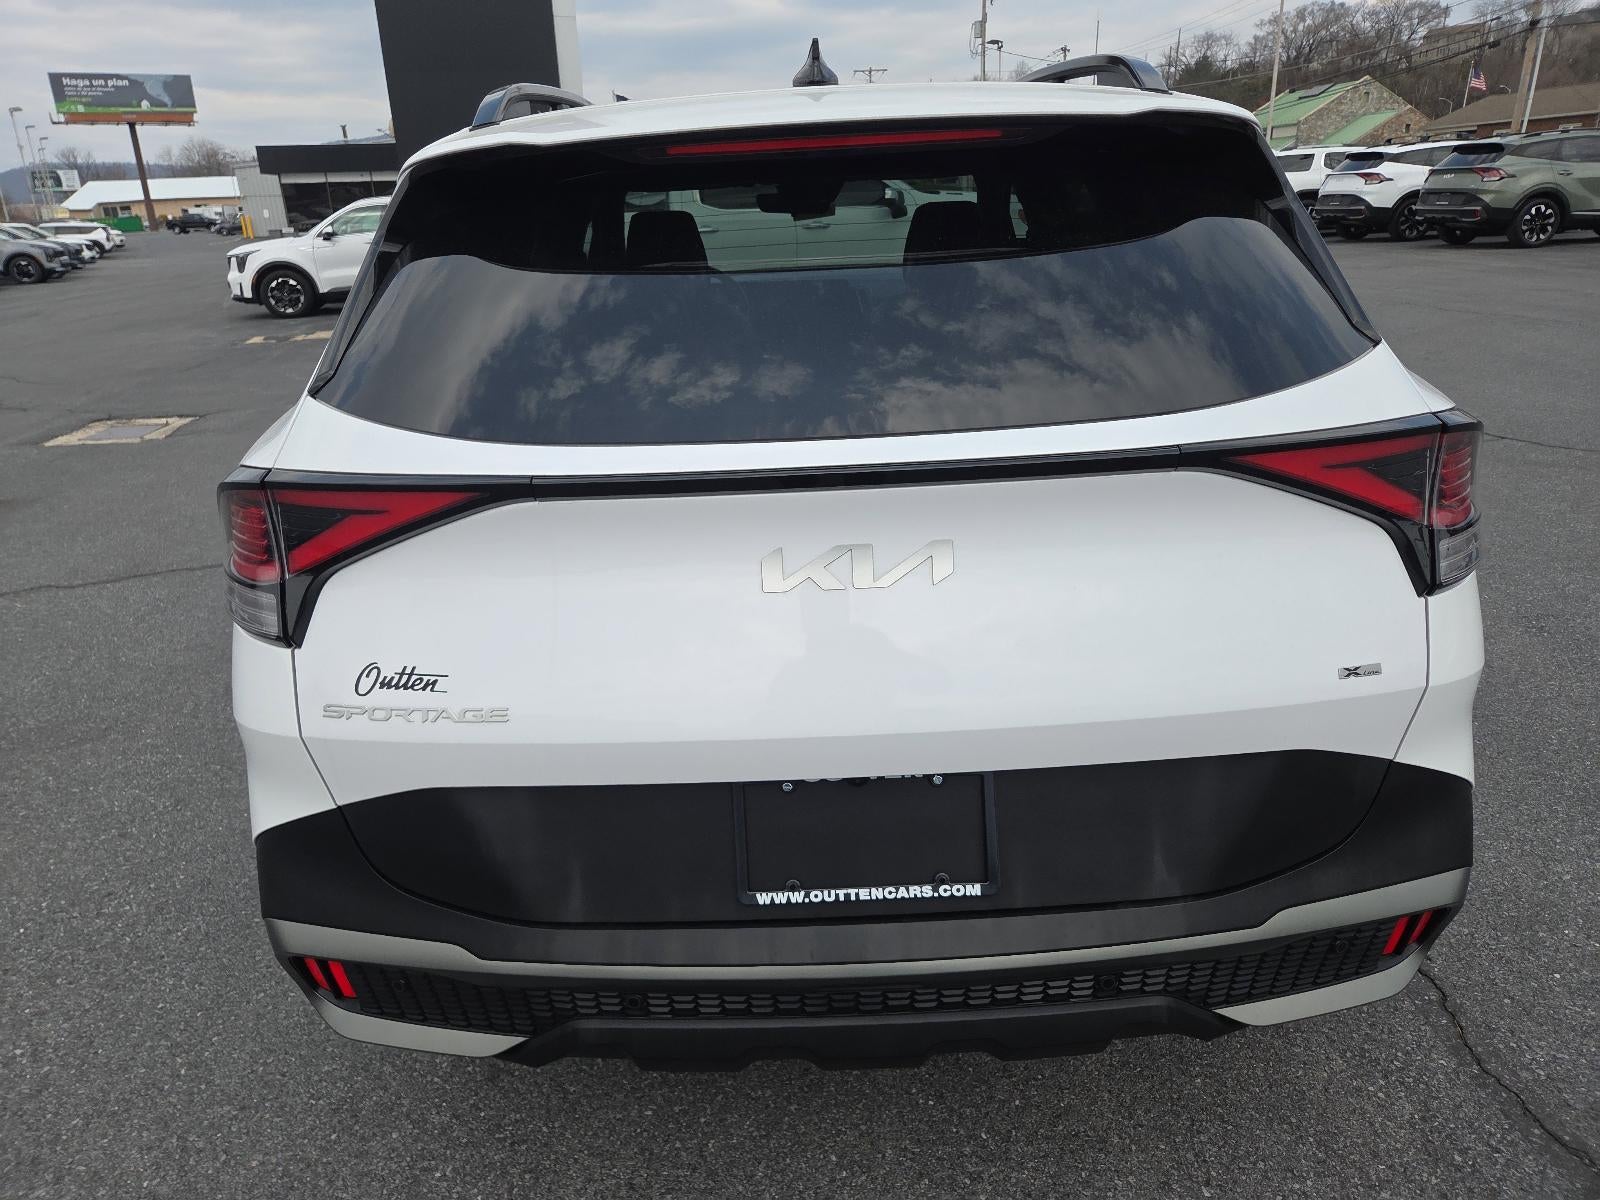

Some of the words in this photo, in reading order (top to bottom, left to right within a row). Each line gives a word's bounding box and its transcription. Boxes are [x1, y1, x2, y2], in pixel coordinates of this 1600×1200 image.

[62, 77, 90, 87] Haga
[107, 78, 129, 88] plan
[761, 539, 955, 593] KIA
[354, 662, 449, 697] Outten
[322, 703, 510, 724] SPORTAGE
[755, 884, 982, 905] WWW.OUTTENCARS.COM
